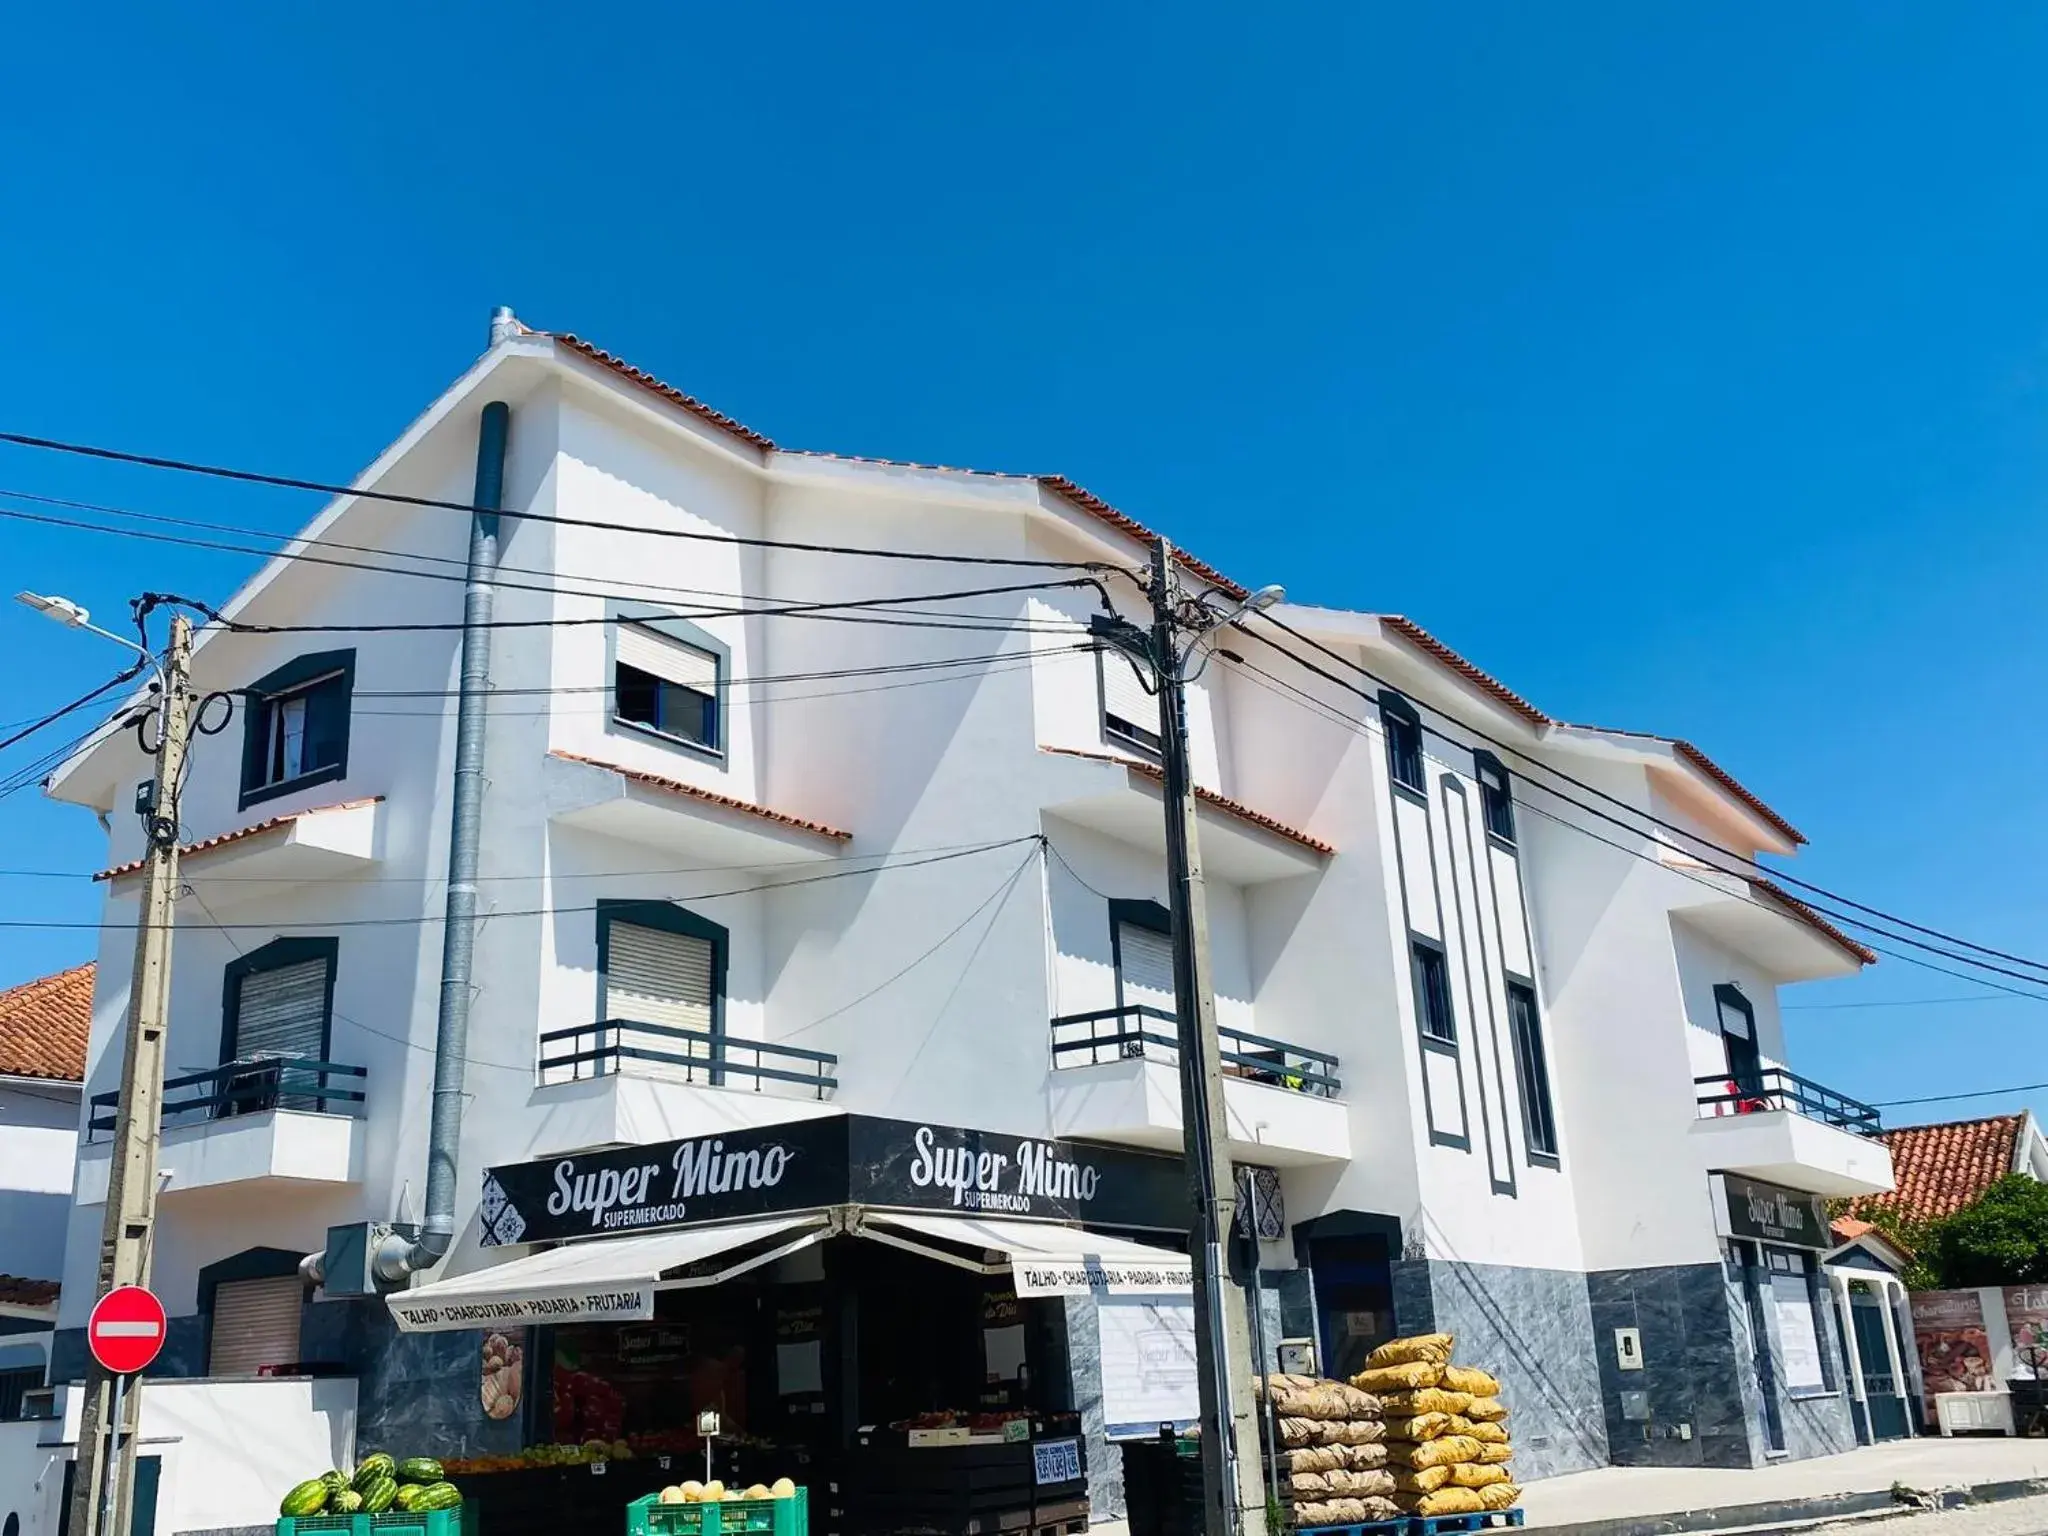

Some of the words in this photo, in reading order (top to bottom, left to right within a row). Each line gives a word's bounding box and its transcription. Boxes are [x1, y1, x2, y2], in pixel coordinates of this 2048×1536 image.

[910, 1127, 1007, 1206] Super
[1016, 1140, 1100, 1201] Mimo
[547, 1160, 659, 1226] Super
[672, 1139, 795, 1199] Mimo
[964, 1191, 1030, 1212] SUPERMERCADO
[604, 1205, 685, 1228] SUPERMERCADO
[1025, 1271, 1058, 1288] TALHO
[1063, 1271, 1124, 1286] CHARCUTARIA
[1128, 1271, 1162, 1285] PADARIA
[401, 1308, 438, 1325] TALHO
[446, 1303, 524, 1322] CHARCUTARIA
[529, 1298, 579, 1316] PADARIA
[587, 1292, 642, 1311] FRUTARIA
